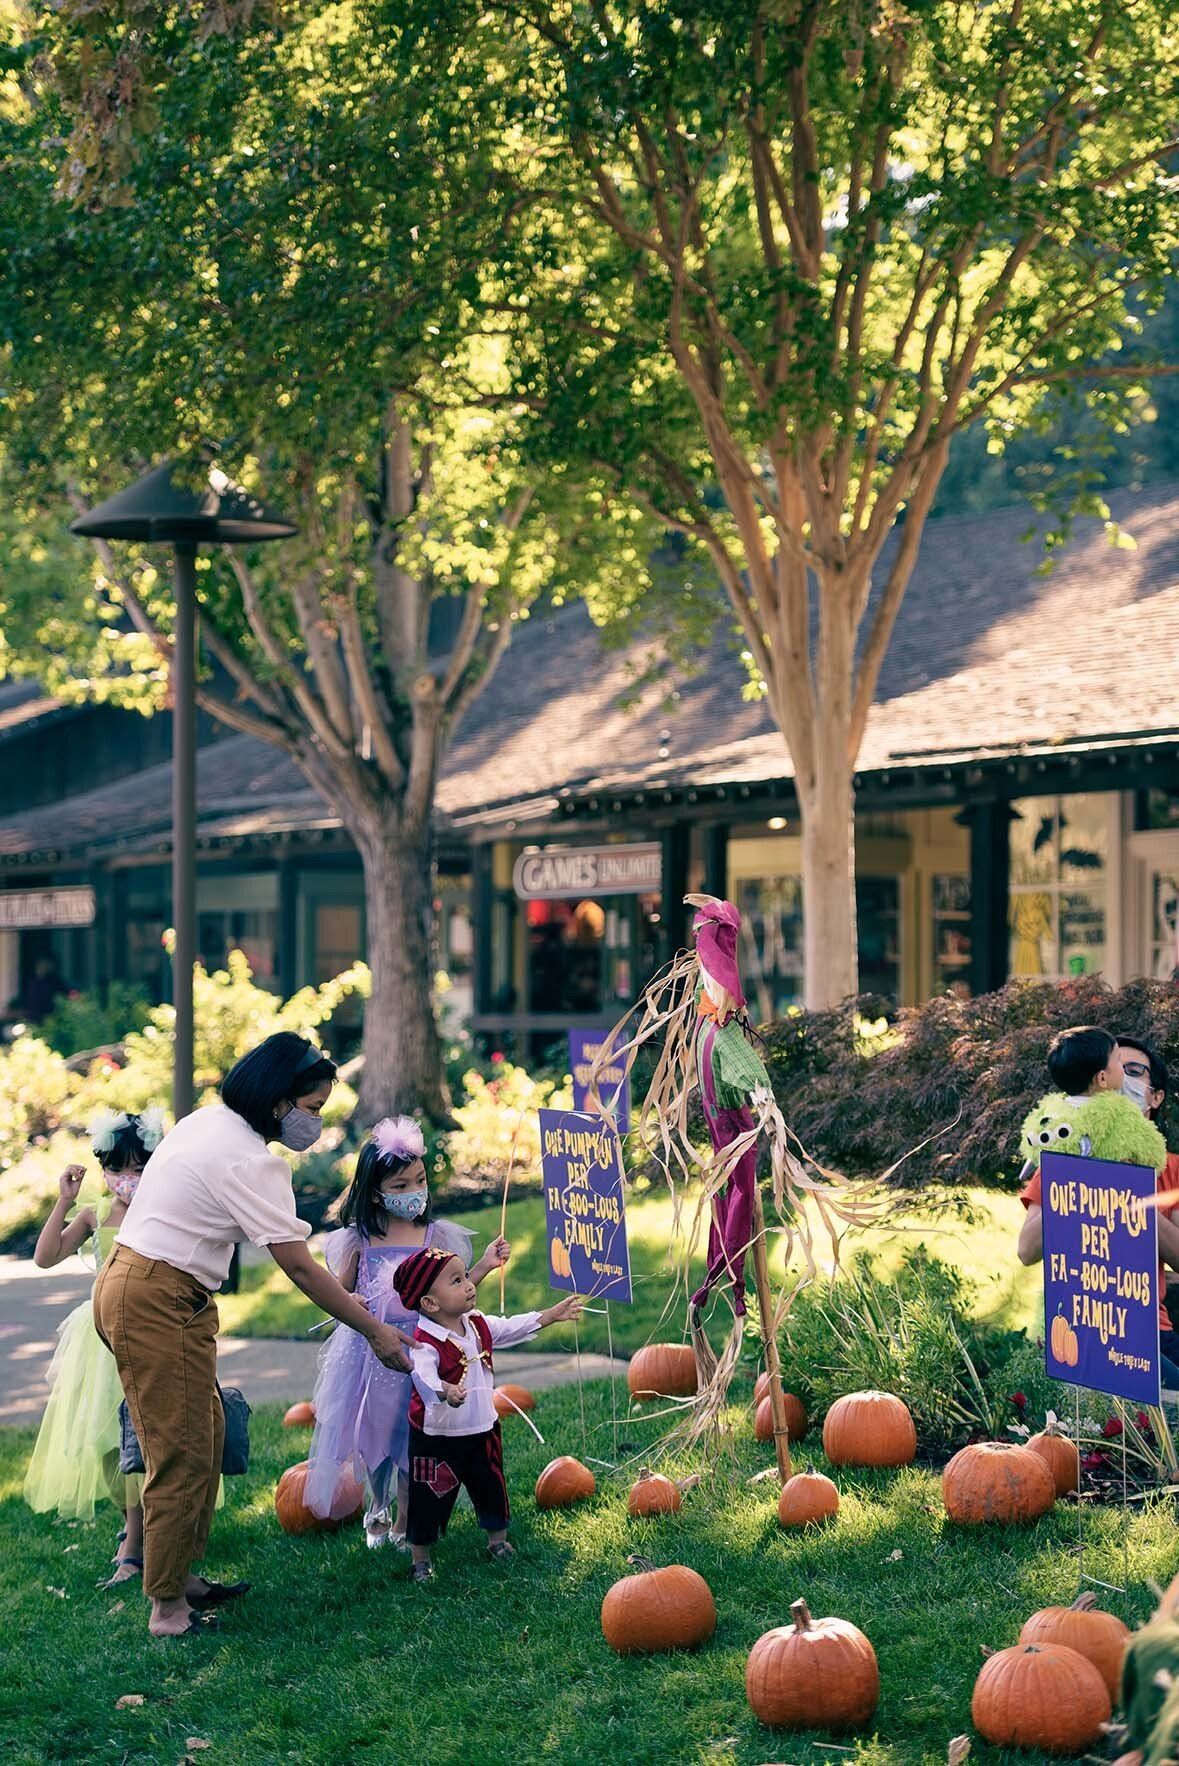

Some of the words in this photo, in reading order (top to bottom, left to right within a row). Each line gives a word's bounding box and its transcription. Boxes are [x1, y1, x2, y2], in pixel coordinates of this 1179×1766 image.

[522, 854, 597, 892] GAMES
[598, 854, 661, 882] UNLIMITE
[545, 1129, 564, 1157] ONE
[567, 1161, 589, 1190] PER
[1049, 1181, 1077, 1217] ONE
[1079, 1182, 1148, 1238] PUMPKIN
[565, 1219, 604, 1258] FAMILY
[1081, 1223, 1110, 1261] PER
[1072, 1294, 1128, 1345] FAMILY
[1138, 1358, 1151, 1372] LAST
